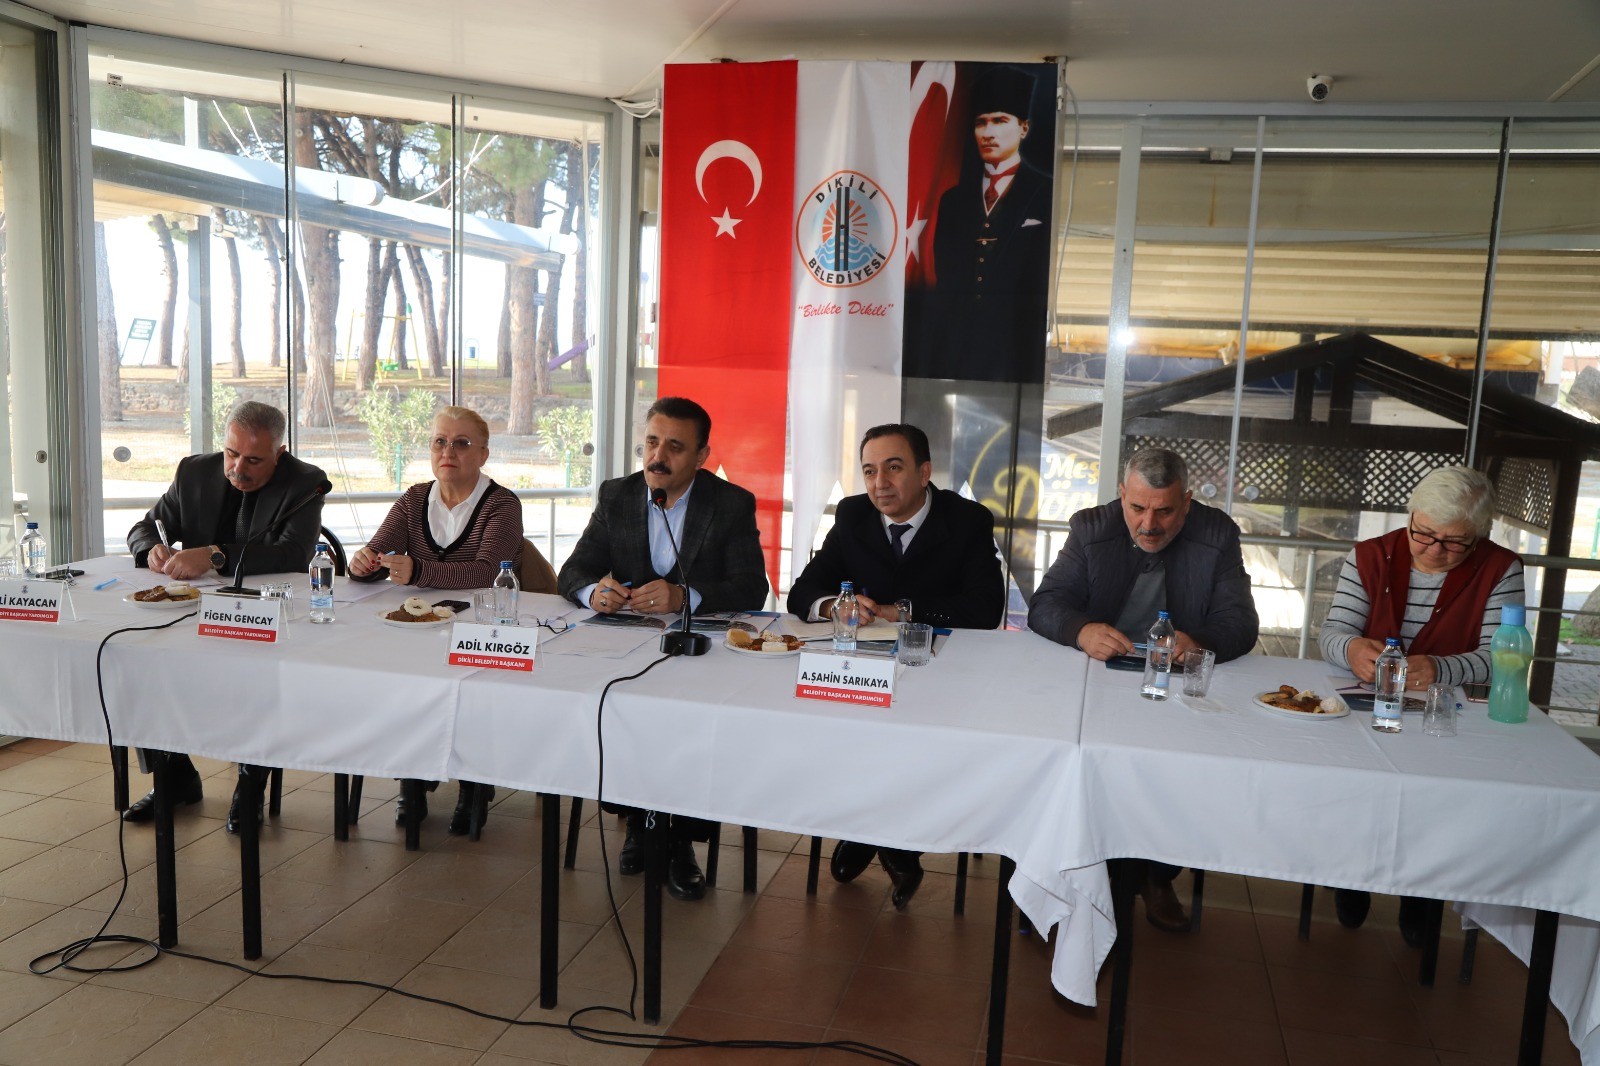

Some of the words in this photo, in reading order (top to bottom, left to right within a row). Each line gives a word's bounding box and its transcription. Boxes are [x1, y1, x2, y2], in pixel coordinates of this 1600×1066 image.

[815, 175, 879, 204] DİKİLİ
[808, 251, 886, 284] BELEDİYESİ
[9, 597, 57, 608] KAYACAN
[204, 610, 232, 622] FİGEN
[234, 614, 274, 626] GENCAY
[456, 638, 482, 651] ADİL
[485, 641, 530, 655] KIRGÖZ
[457, 656, 474, 664] DİKİLİ
[474, 658, 499, 666] BELEDİYE
[499, 660, 526, 668] BAŞKANI
[801, 671, 841, 684] A.ŞAHİN
[842, 675, 889, 689] SARIKAYA
[803, 689, 827, 697] BELEDİYE
[827, 691, 851, 700] BAŞKAN
[851, 694, 884, 703] YARDIMCISI
